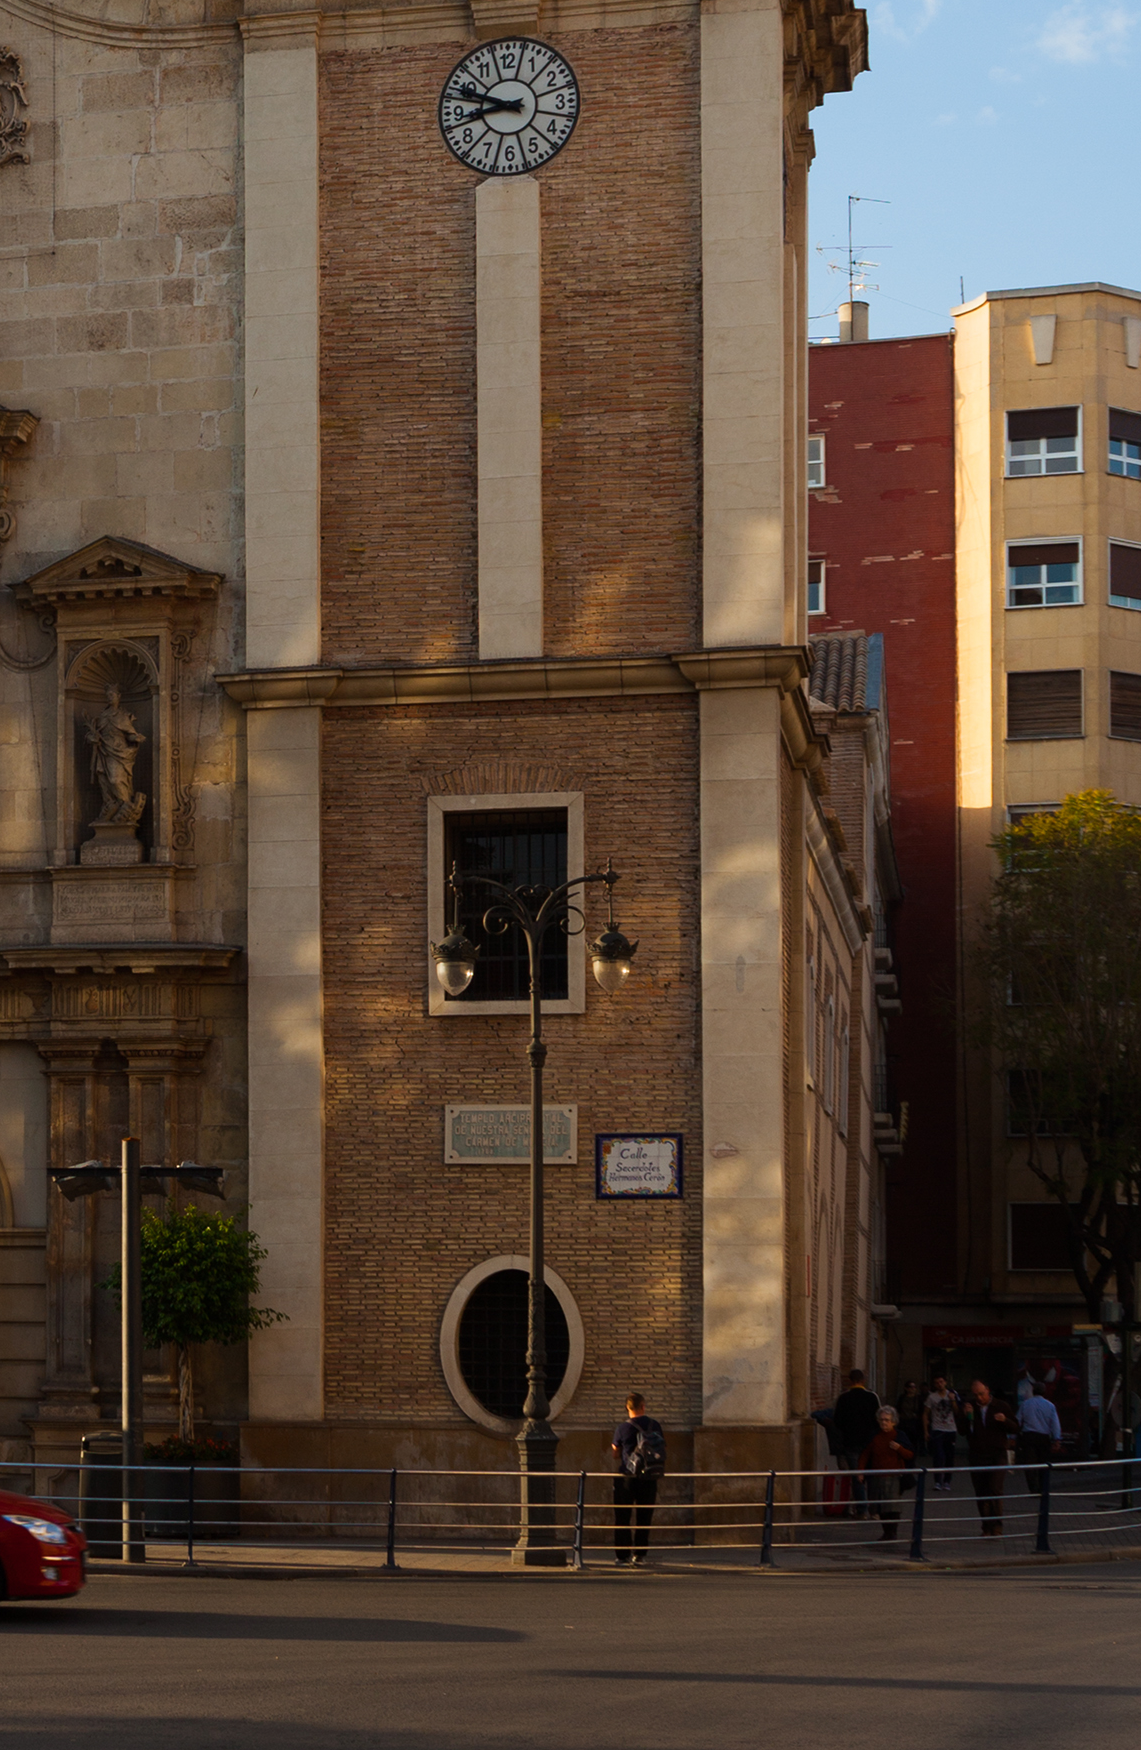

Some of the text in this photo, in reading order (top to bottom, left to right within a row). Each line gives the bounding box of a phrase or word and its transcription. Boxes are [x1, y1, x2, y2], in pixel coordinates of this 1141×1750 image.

[500, 53, 515, 69] 12
[528, 57, 535, 72] 1
[477, 62, 490, 78] 11
[546, 71, 557, 87] 2
[555, 94, 565, 110] 3
[453, 105, 463, 121] 9
[547, 119, 557, 135] 4
[462, 127, 473, 144] 8
[483, 143, 492, 158] 7
[528, 137, 538, 153] 5
[505, 146, 515, 161] 6
[460, 1112, 564, 1123] TEMPLO ARCIPRTAL
[454, 1125, 467, 1135] DE
[470, 1125, 509, 1135] NUESTRA
[549, 1125, 568, 1135] DEL
[505, 1137, 517, 1147] DE
[620, 1147, 648, 1159] Calle
[615, 1162, 660, 1173] Sacerdotes
[608, 1172, 643, 1182] Hermanos
[951, 1335, 1014, 1344] CAJAMURCIA
